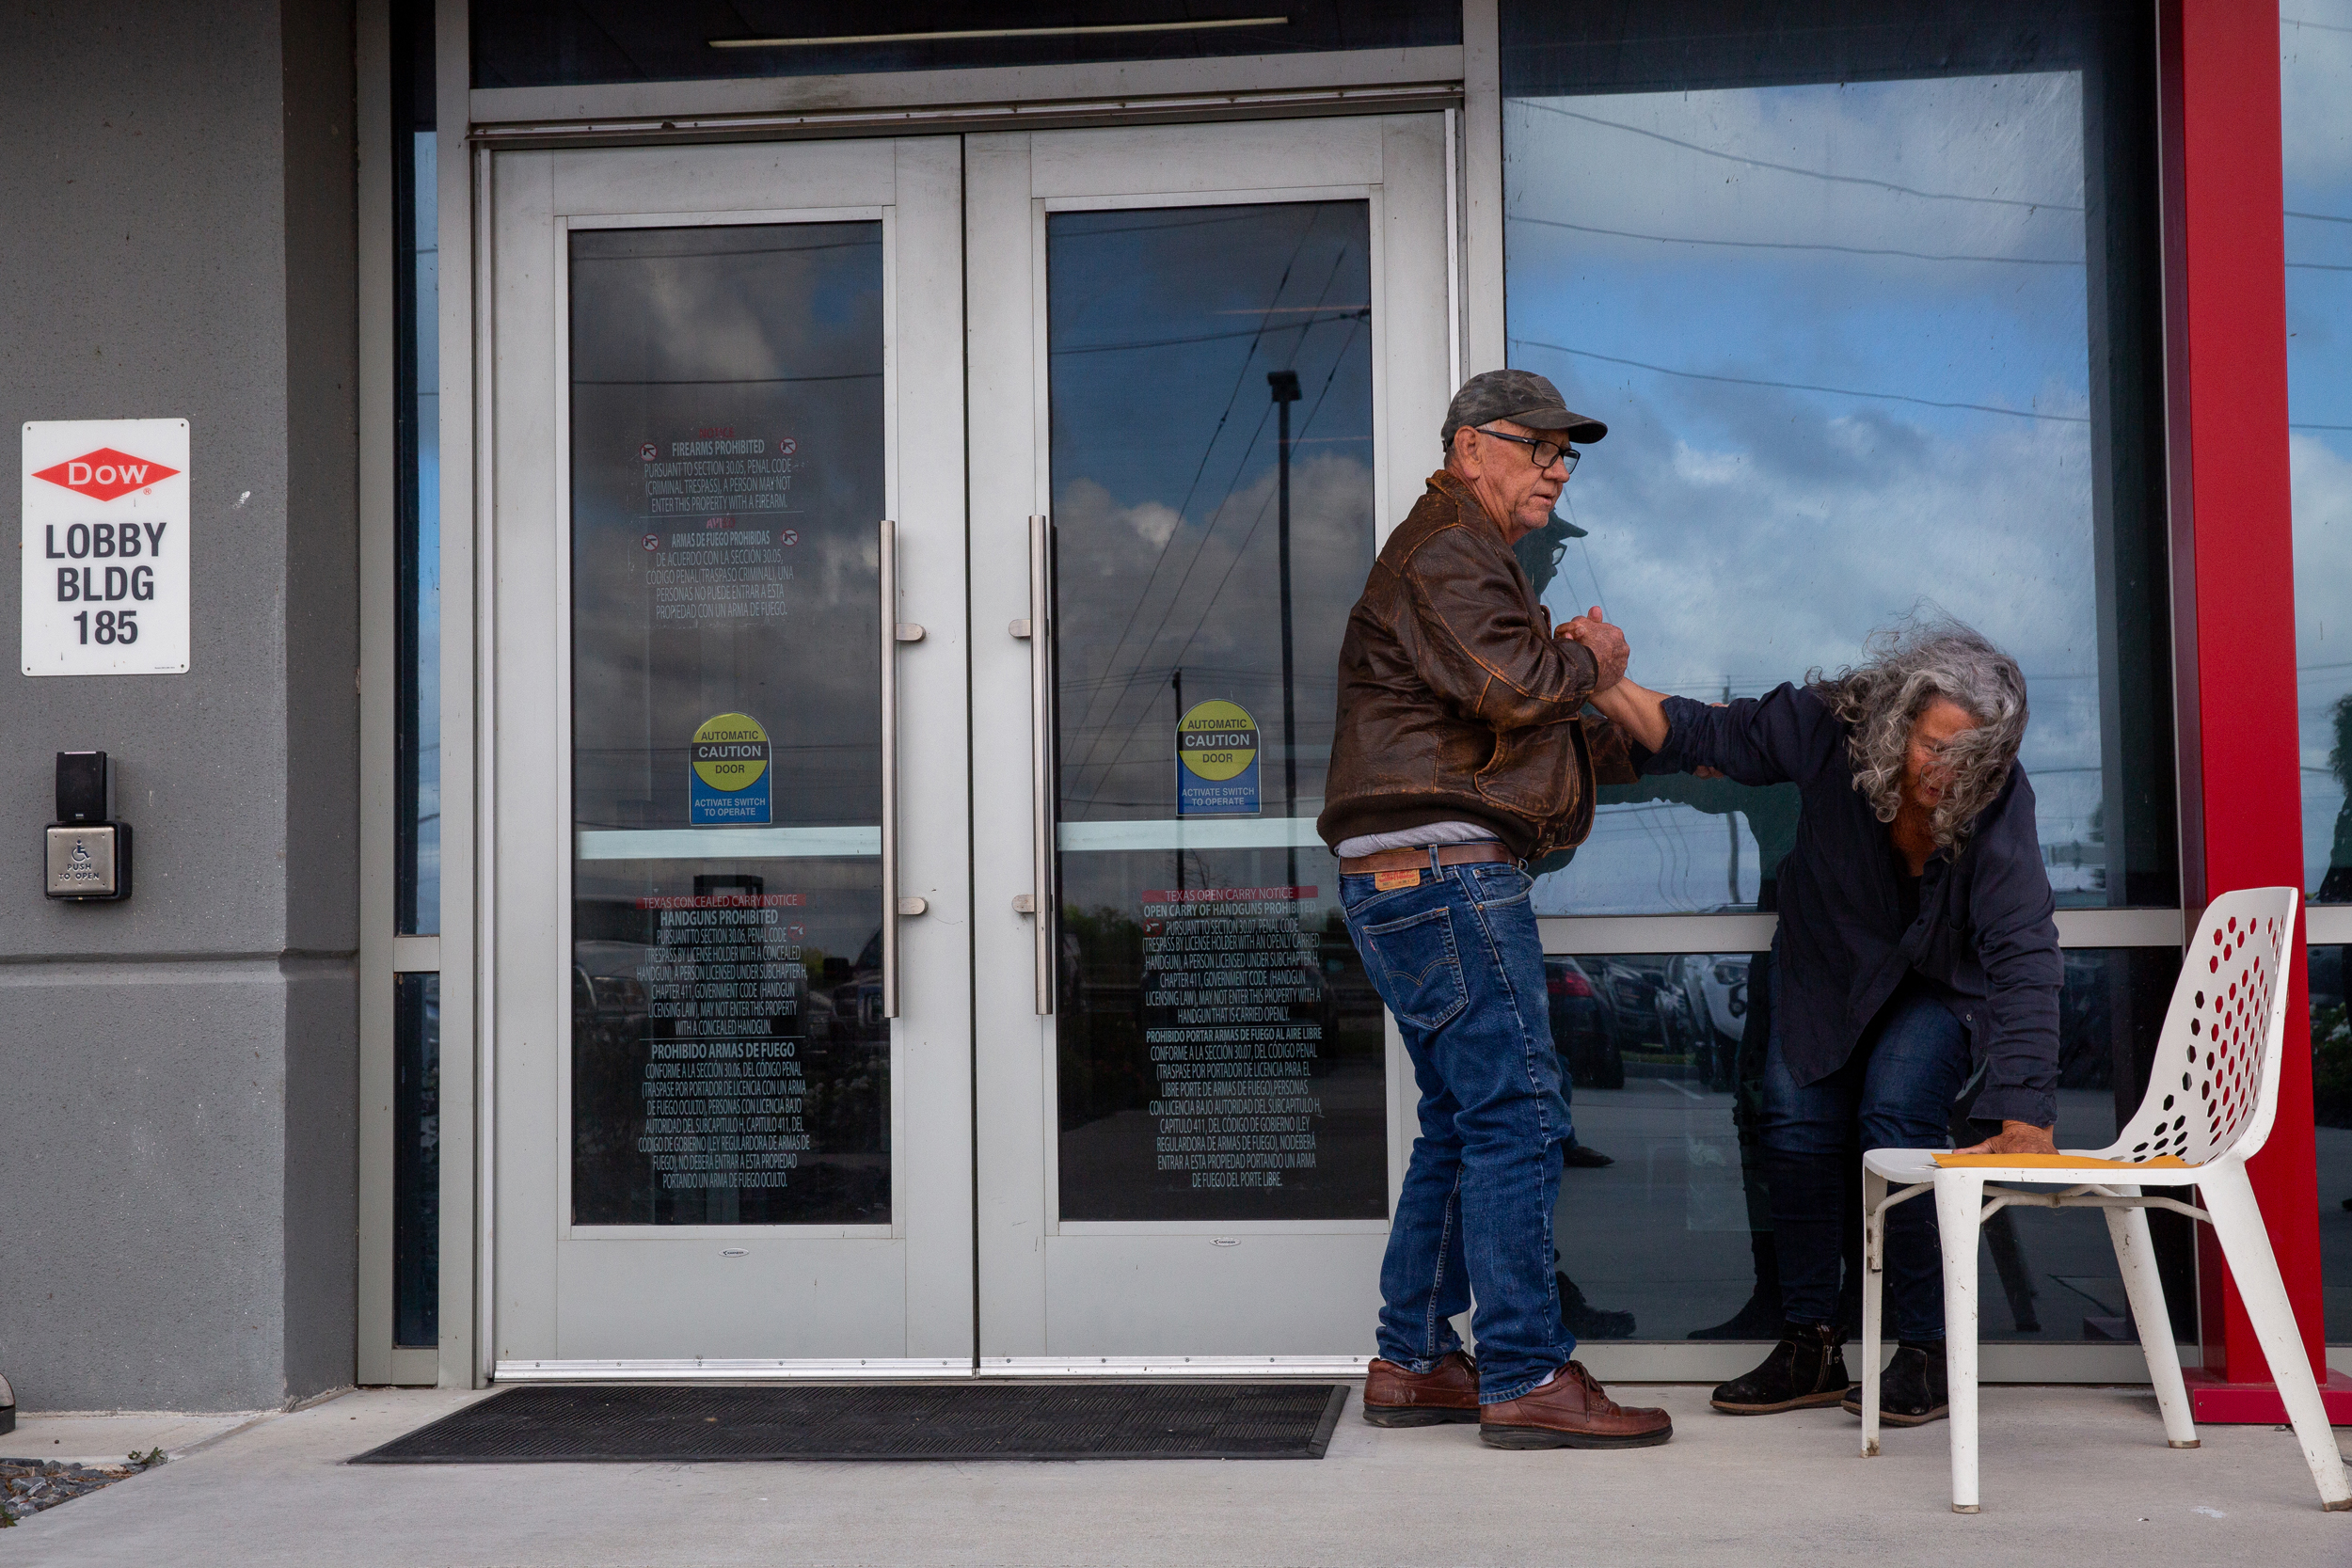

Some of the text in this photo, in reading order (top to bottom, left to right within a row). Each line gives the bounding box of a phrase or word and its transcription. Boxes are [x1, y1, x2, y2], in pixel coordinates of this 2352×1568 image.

[699, 427, 735, 438] NOTICE
[672, 439, 764, 456] FIREARMS PROHIBITED
[644, 459, 791, 478] PURSUANT TO SECTION 30.05, PENAL CODE
[645, 476, 791, 497] (CRIMINAL TRESPASS), A PERSON MAY NOT
[652, 494, 787, 512] ENTER THIS PROPERTY WITH A FIREARM.
[707, 517, 735, 529] AVISO
[46, 522, 167, 559] LOBBY
[672, 531, 770, 547] ARMAS DE FUEGO PROHIBIDAS
[57, 565, 153, 602] BLDG
[73, 610, 137, 645] 185
[1187, 719, 1247, 729] AUTOMATIC
[701, 731, 758, 740] AUTOMATIC
[1185, 734, 1249, 747] CAUTION
[698, 745, 761, 758] CAUTION
[1203, 753, 1232, 763] DOOR
[715, 765, 744, 774] DOOR
[1182, 787, 1254, 797] ACTIVATE SWITCH
[695, 798, 765, 807] ACTIVATE SWITCH
[1192, 798, 1244, 806] TO OPERATE
[705, 808, 715, 816] TO
[644, 895, 797, 909] TEXAS CONCEALED CARRY NOTICE
[1166, 888, 1294, 901] TEXAS OPEN CARRY NOTICE
[660, 909, 778, 926] HANDGUNS PROHIBITED
[1144, 901, 1315, 917] OPEN CARRY OF HANDGUNS PROHIBITED
[1167, 918, 1298, 935] PURSUANT TO SECTION 30.07, PENAL CODE
[657, 927, 787, 944] PURSUANT TO SECTION 30.06, PENAL CODE
[1143, 933, 1320, 954] (TRESPASS BY LICENSE HOLDER WITH AN OPENLY CARRIED
[645, 945, 801, 965] (TRESPASS BY LICENSE HOLDER WITH A CONCEALED
[1146, 952, 1319, 972] HANDGUN), A PERSON LICENSED UNDER SUBCHAPTER H,
[637, 964, 807, 983] HANDGUN), A PERSON LICENSED UNDER SUBCHAPTER H,
[1160, 970, 1305, 989] CHAPTER 411, GOVERNMENT CODE (HANDGUN
[652, 982, 794, 1000] CHAPTER 411, GOVERNMENT CODE (HANDGUN
[1146, 990, 1179, 1006] LICENSING
[1200, 990, 1213, 1005] MAY
[1215, 990, 1227, 1005] NOT
[1229, 989, 1248, 1005] ENTER
[1249, 989, 1263, 1004] THIS
[1264, 988, 1296, 1004] PROPERTY
[1298, 988, 1314, 1003] WITH
[1316, 988, 1321, 1003] A
[648, 1002, 680, 1018] LICENSING
[701, 1002, 714, 1017] MAY
[716, 1001, 728, 1017] NOT
[730, 1001, 749, 1016] ENTER
[750, 1001, 764, 1016] THIS
[766, 1000, 797, 1016] PROPERTY
[1178, 1006, 1290, 1023] HANDGUN THAT IS CARRIED OPENLY.
[675, 1020, 771, 1035] WITH A CONCEALED HANDGUN.
[1147, 1027, 1322, 1042] PROHIBIDO PORTAR ARMAS DE FUEGO AL AIRE LIBRE
[652, 1042, 795, 1059] PROHIBIDO ARMAS DE FUEGO
[1193, 1172, 1282, 1187] DE FUEGO DEL PORTE LIBRE.
